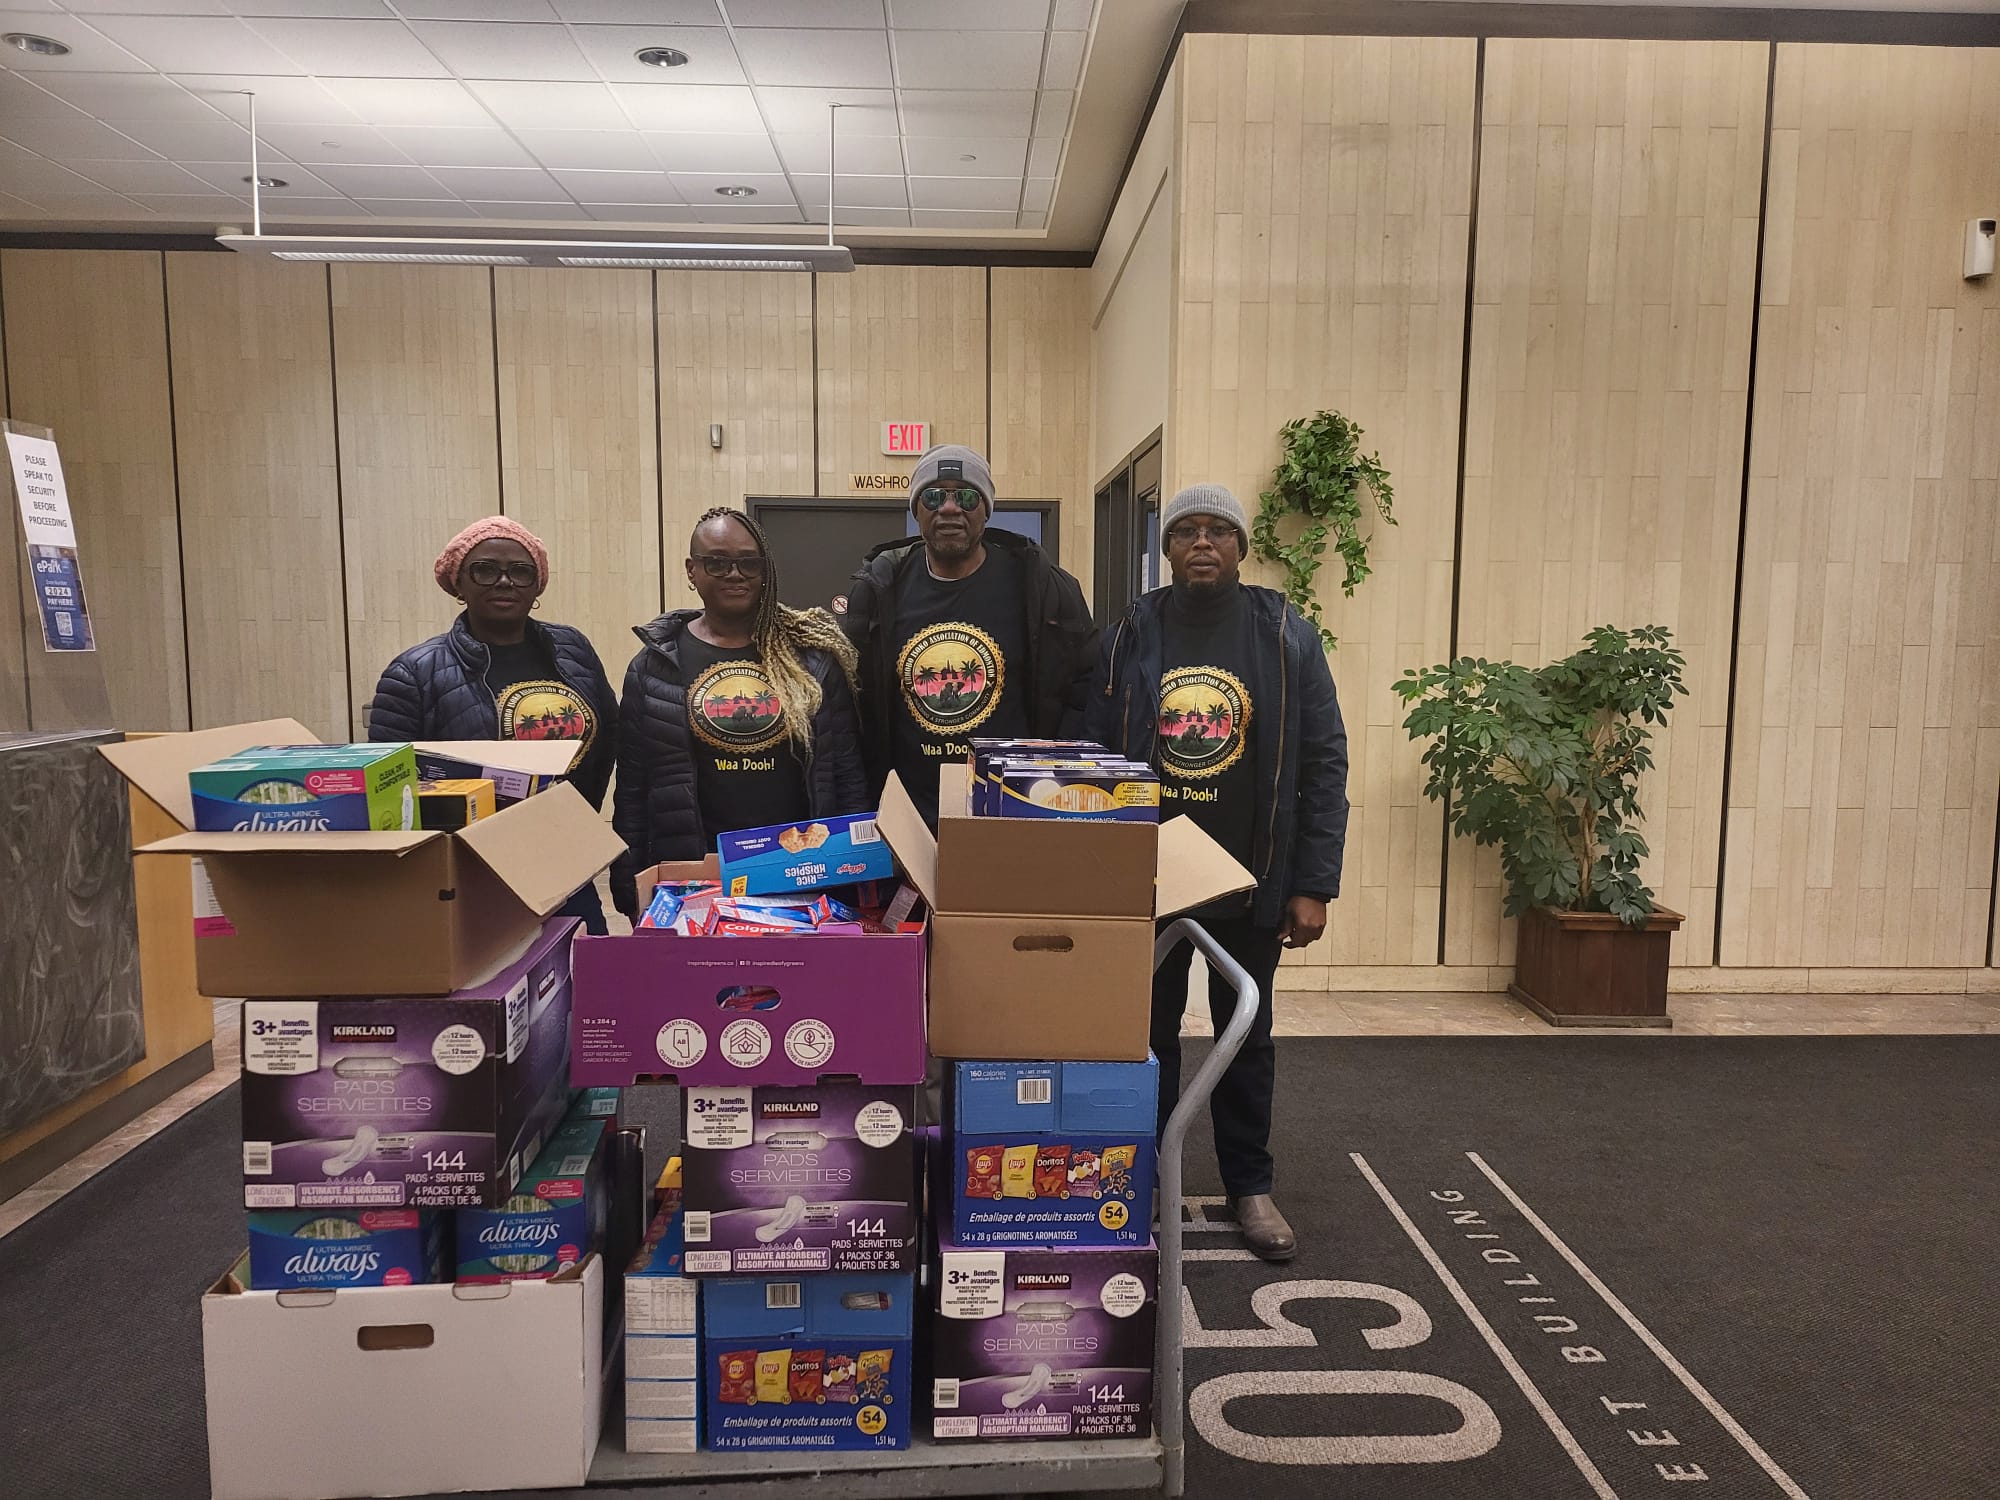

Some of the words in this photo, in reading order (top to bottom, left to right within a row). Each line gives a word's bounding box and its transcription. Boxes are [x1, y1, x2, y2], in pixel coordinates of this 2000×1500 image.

[889, 424, 924, 451] EXIT
[25, 455, 47, 466] PLEASE
[24, 470, 44, 480] SPEAK
[45, 473, 53, 482] TO
[854, 476, 910, 488] WASHRO
[27, 485, 55, 496] SECURITY
[33, 501, 56, 512] BEFORE
[28, 516, 68, 528] PROCEEDING
[37, 560, 62, 574] ePark
[48, 587, 68, 596] 2024
[929, 632, 969, 644] ASSOCIATION
[970, 638, 978, 646] OF
[976, 643, 995, 678] EDMONTON
[720, 668, 759, 679] ASSOCIATION
[1178, 675, 1219, 686] ASSOCIATION
[1219, 683, 1228, 692] OF
[1226, 688, 1240, 724] EDMONTON
[920, 744, 942, 756] Waa
[945, 742, 968, 754] Doo
[715, 759, 739, 771] Waa
[742, 758, 775, 771] Dooh!
[1182, 787, 1218, 802] Dooh!
[233, 812, 330, 831] always
[733, 886, 744, 894] 54
[724, 923, 788, 934] Colgate
[252, 1020, 277, 1035] 3+
[333, 1026, 395, 1036] KIRKLAND
[661, 1021, 682, 1035] ALBERTA
[682, 1021, 702, 1034] GROWN
[723, 1021, 755, 1039] GREENHOUSE
[756, 1024, 768, 1039] CLEAN
[787, 1021, 816, 1039] SUSTAINABLY
[684, 1049, 704, 1066] ALBERTA
[334, 1081, 395, 1094] PADS
[297, 1097, 432, 1112] SERVIETTES
[694, 1098, 716, 1113] 3+
[764, 1103, 818, 1112] KIRKLAND
[422, 1150, 466, 1171] 144
[764, 1154, 818, 1166] PADS
[1037, 1158, 1064, 1168] Doritos
[405, 1174, 428, 1183] PADS
[436, 1172, 485, 1182] SERVIETTES
[730, 1168, 852, 1183] SERVIETTES
[301, 1186, 342, 1194] ULTIMATE
[344, 1186, 399, 1194] ABSORBENCY
[415, 1187, 420, 1195] 4
[422, 1186, 450, 1195] PACKS
[452, 1186, 463, 1194] OF
[465, 1186, 476, 1194] 36
[301, 1195, 354, 1203] ABSORPTION
[356, 1194, 401, 1203] MAXIMALE
[409, 1197, 415, 1205] 4
[417, 1196, 455, 1205] PAQUETS
[457, 1196, 468, 1204] DE
[470, 1196, 482, 1204] 36
[969, 1212, 1013, 1224] Emballage
[1014, 1212, 1026, 1221] de
[1027, 1212, 1062, 1223] produits
[1064, 1211, 1095, 1221] assortis
[1105, 1207, 1123, 1219] 54
[479, 1219, 560, 1247] always
[846, 1218, 886, 1237] 144
[962, 1233, 970, 1241] 54
[977, 1233, 985, 1241] 28
[986, 1234, 990, 1242] g
[992, 1232, 1033, 1240] GRIGNOTINES
[1035, 1230, 1077, 1240] AROMATISÉES
[1116, 1232, 1127, 1241] 1,51
[1128, 1232, 1136, 1241] kg
[832, 1240, 852, 1248] PADS
[859, 1239, 903, 1248] SERVIETTES
[738, 1252, 774, 1260] ULTIMATE
[775, 1251, 826, 1259] ABSORBENCY
[840, 1252, 844, 1260] 4
[847, 1251, 871, 1260] PACKS
[873, 1251, 883, 1259] OF
[885, 1251, 895, 1259] 36
[284, 1246, 380, 1280] always
[737, 1260, 785, 1268] ABSORPTION
[787, 1260, 827, 1268] MAXIMALE
[842, 1261, 876, 1270] PAQUETS
[878, 1261, 888, 1269] DE
[890, 1261, 900, 1269] 36
[948, 1271, 969, 1284] 3+
[1018, 1275, 1069, 1284] KIRKLAND
[1430, 1188, 1608, 1363] BUILDING
[1016, 1323, 1068, 1335] PADS
[984, 1337, 1098, 1351] SERVIETTES
[792, 1363, 819, 1372] Doritos
[1088, 1384, 1125, 1403] 144
[1072, 1405, 1092, 1414] PADS
[1098, 1404, 1140, 1413] SERVIETTES
[724, 1417, 768, 1428] Emballage
[770, 1416, 781, 1425] de
[782, 1416, 818, 1428] produits
[820, 1416, 853, 1426] assortis
[863, 1411, 881, 1423] 54
[984, 1418, 1018, 1426] ULTIMATE
[1019, 1416, 1067, 1424] ABSORBENCY
[1080, 1417, 1084, 1425] 4
[1087, 1416, 1110, 1425] PACKS
[1112, 1416, 1122, 1424] OF
[1123, 1415, 1132, 1423] 36
[982, 1426, 1028, 1434] ABSORPTION
[1029, 1424, 1068, 1432] MAXIMALE
[1075, 1426, 1079, 1434] 4
[1082, 1425, 1113, 1434] PAQUETS
[1127, 1424, 1136, 1432] 36
[716, 1438, 725, 1446] 54
[747, 1437, 790, 1446] GRIGNOTINES
[792, 1435, 835, 1445] AROMATISÉES
[875, 1437, 886, 1446] 1,51
[887, 1436, 896, 1446] kg
